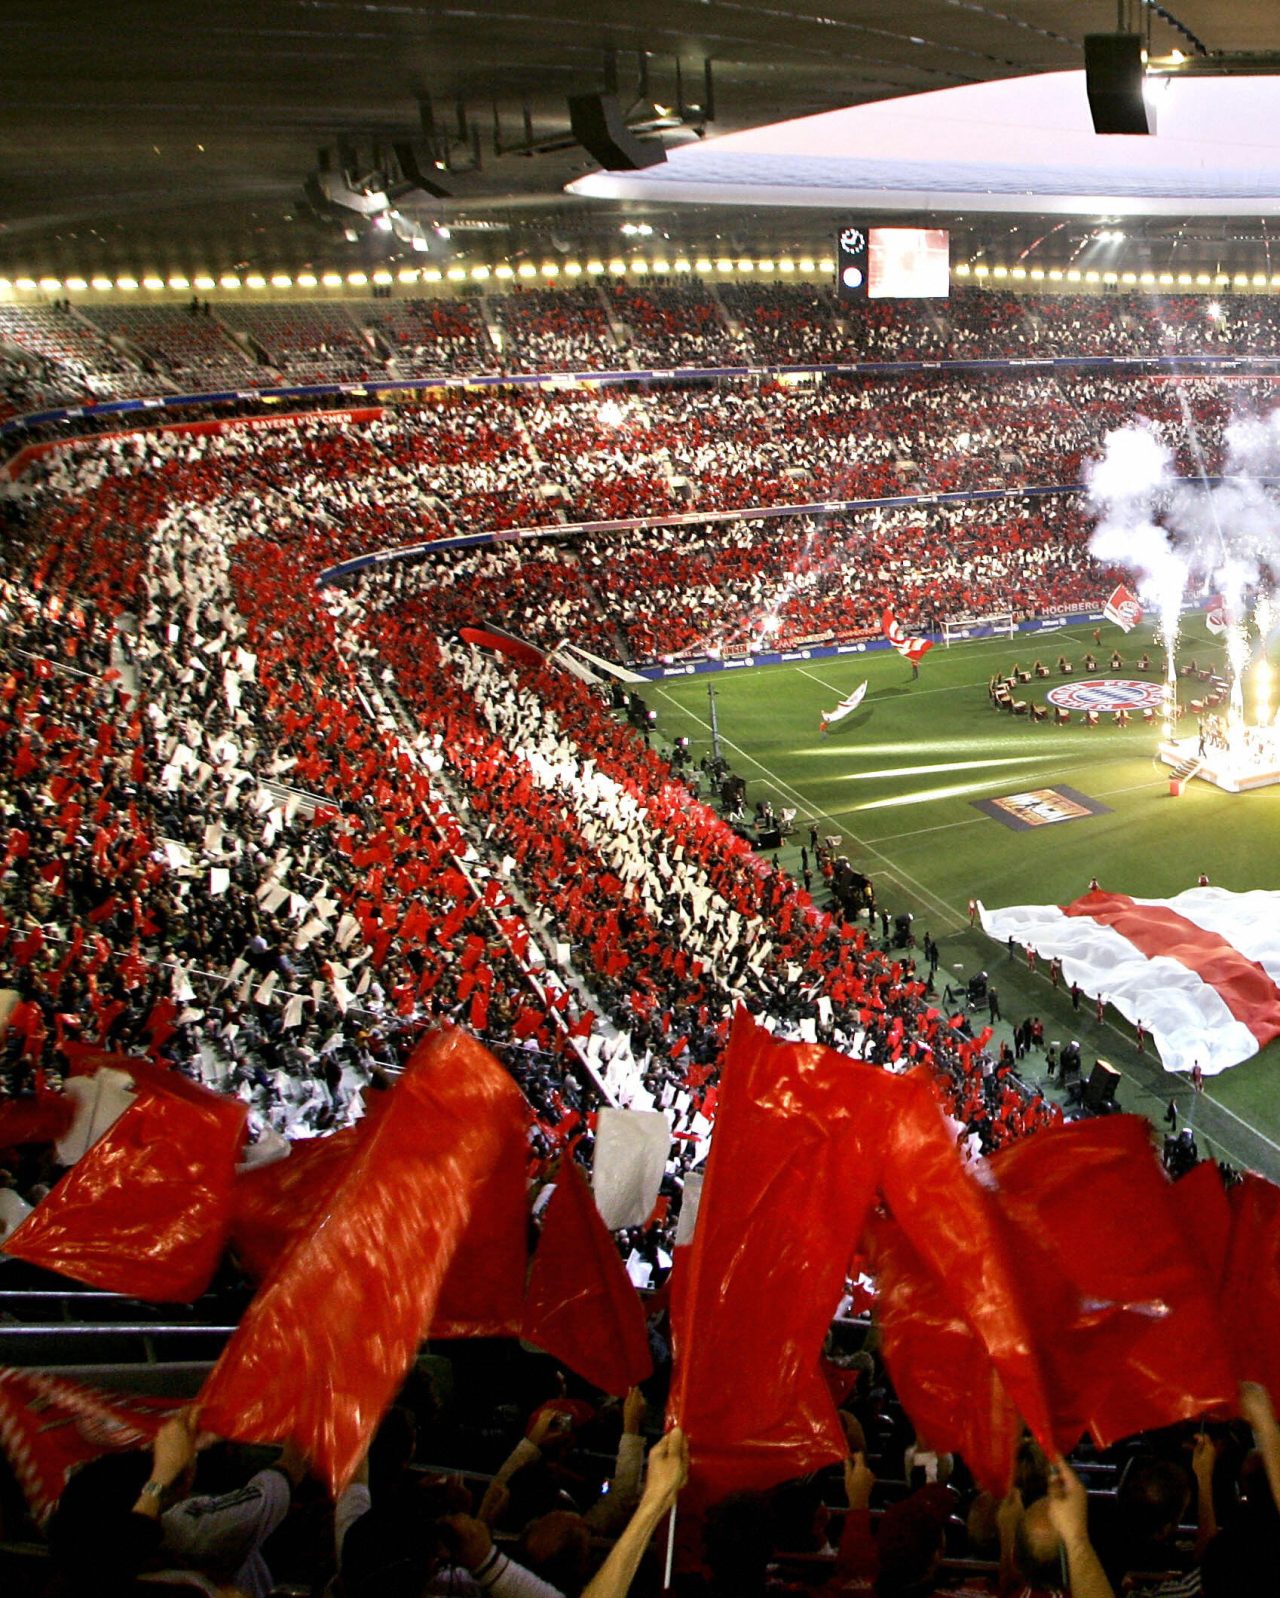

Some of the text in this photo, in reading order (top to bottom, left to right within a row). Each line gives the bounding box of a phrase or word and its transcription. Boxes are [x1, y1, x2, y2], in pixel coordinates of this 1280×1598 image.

[252, 418, 296, 429] BAYERN
[1042, 601, 1100, 615] HOCHBERG
[724, 660, 745, 668] Allianz
[664, 668, 686, 676] Allianz
